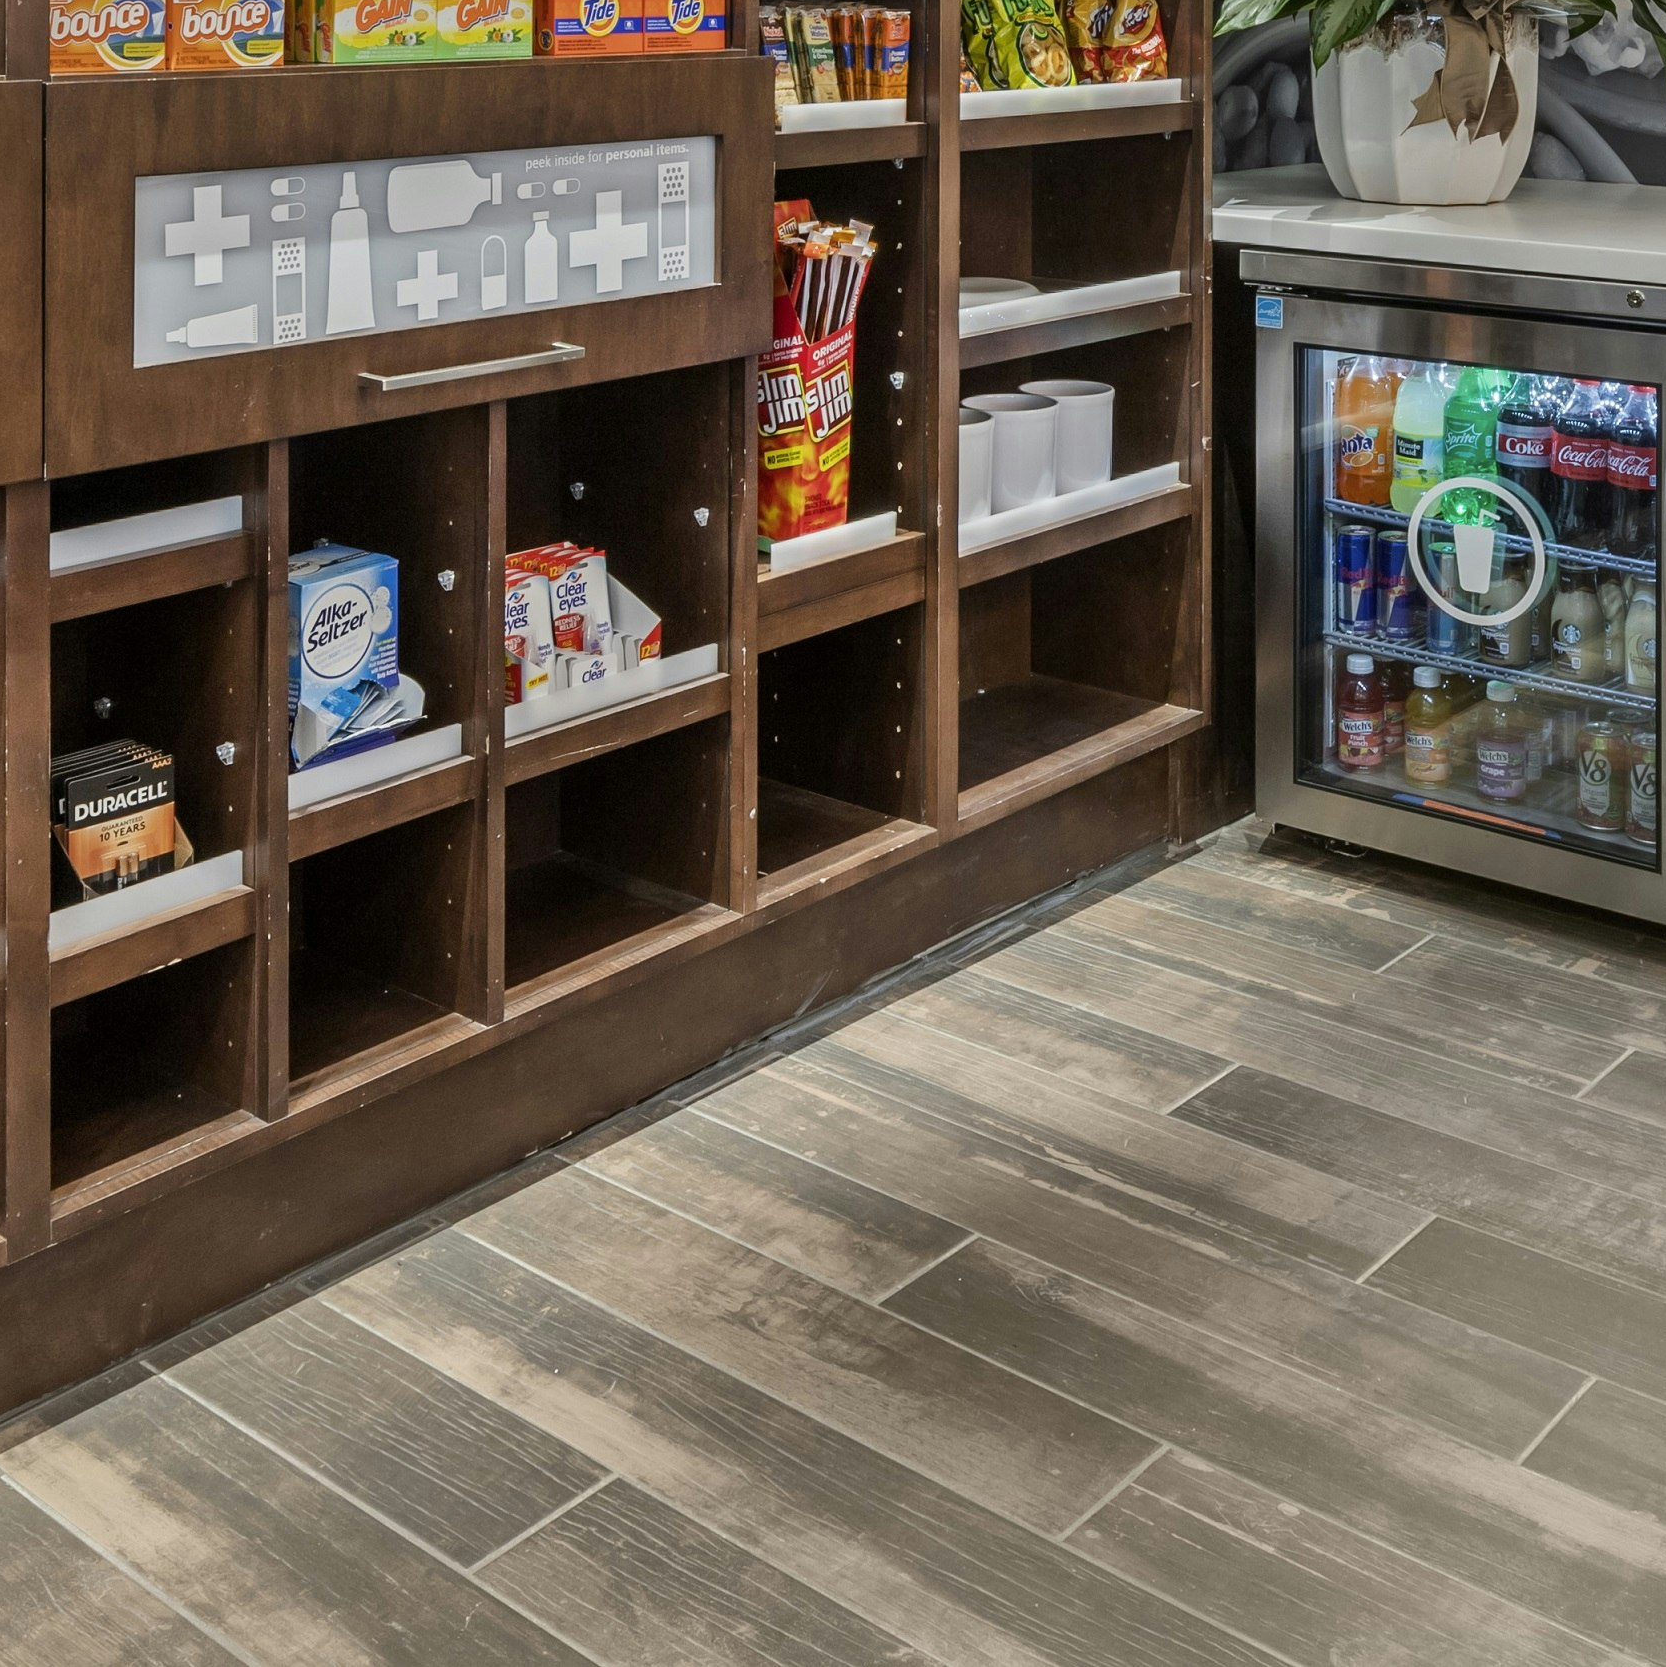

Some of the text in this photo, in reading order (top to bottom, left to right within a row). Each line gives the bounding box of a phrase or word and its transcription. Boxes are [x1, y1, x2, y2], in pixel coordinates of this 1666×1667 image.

[50, 2, 146, 42] bounce
[181, 1, 268, 40] bounce
[525, 142, 689, 172] peek inside for personal items.
[812, 330, 853, 361] ORIGINAL
[1339, 433, 1373, 455] anta
[1445, 430, 1478, 449] Sprite
[1505, 437, 1545, 455] Coke
[556, 581, 587, 600] Clear
[559, 594, 587, 613] eyes
[310, 600, 358, 633] Alka-
[307, 610, 368, 654] Seltzer
[582, 667, 607, 684] Clear
[1343, 720, 1373, 733] Welch's
[152, 757, 172, 770] AAA2
[1480, 764, 1505, 777] Grape
[1581, 751, 1607, 783] V8
[74, 781, 168, 823] DURACELL
[99, 820, 146, 843] 10 YEARS
[101, 816, 144, 833] GUARANTEED
